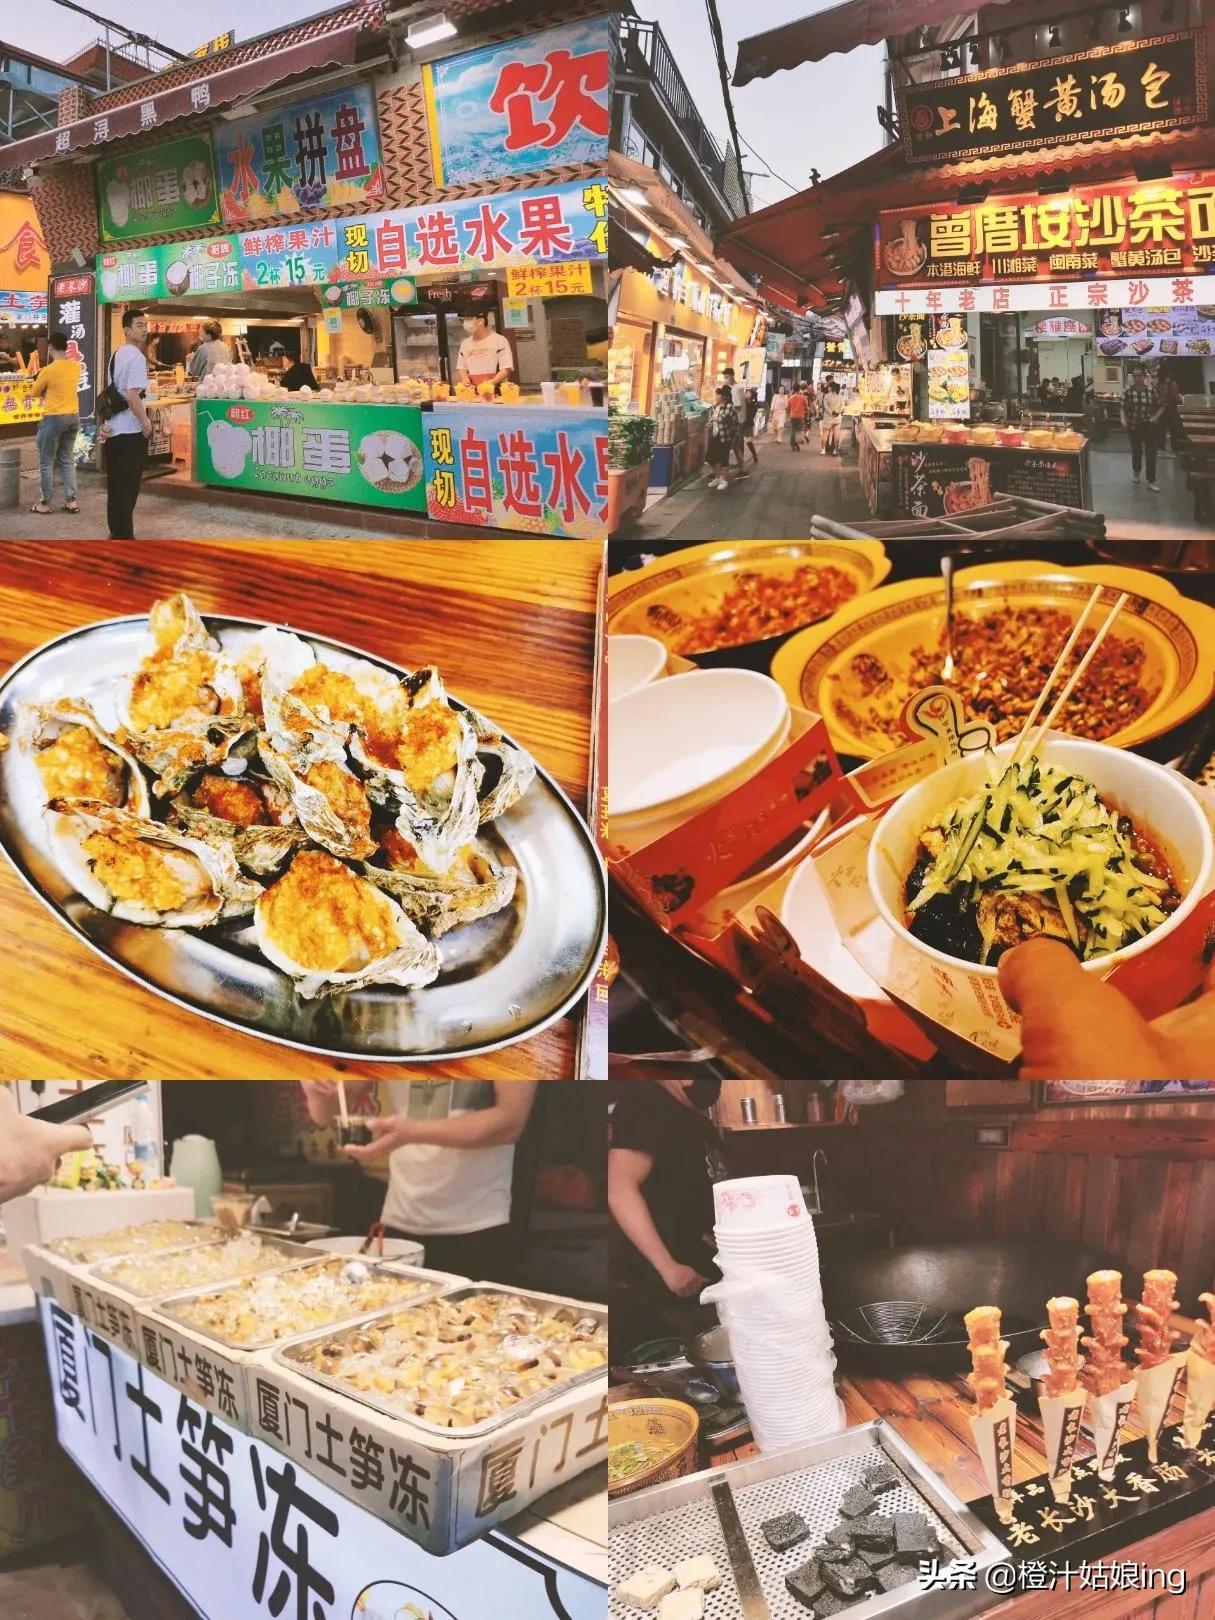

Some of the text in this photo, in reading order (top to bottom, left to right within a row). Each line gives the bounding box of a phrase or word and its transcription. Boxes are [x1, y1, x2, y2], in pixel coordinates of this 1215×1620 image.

[489, 50, 608, 150] 饮
[935, 62, 1171, 136] 上海蟹黄汤包
[226, 104, 372, 202] 水果拼盘
[242, 225, 335, 257] 鲜榨果汁
[345, 223, 369, 274] 现切
[374, 195, 575, 272] 自选水果
[926, 245, 1215, 278] 本港海鲜 川湘菜 闽南菜 蟹黄汤包 沙
[427, 288, 453, 300] Fresh
[511, 263, 586, 281] 鲜榨果汁
[515, 279, 586, 297] 2杯15元
[894, 279, 1195, 312] 十年老店 正宗沙茶
[251, 426, 352, 474] 椰蛋
[429, 427, 456, 508] 现切
[459, 427, 608, 524] 自选水
[141, 1324, 240, 1421] 厦门土笋冻
[50, 1302, 341, 1620] 厦门土笋冻
[256, 1377, 431, 1531] 厦门土笋冻
